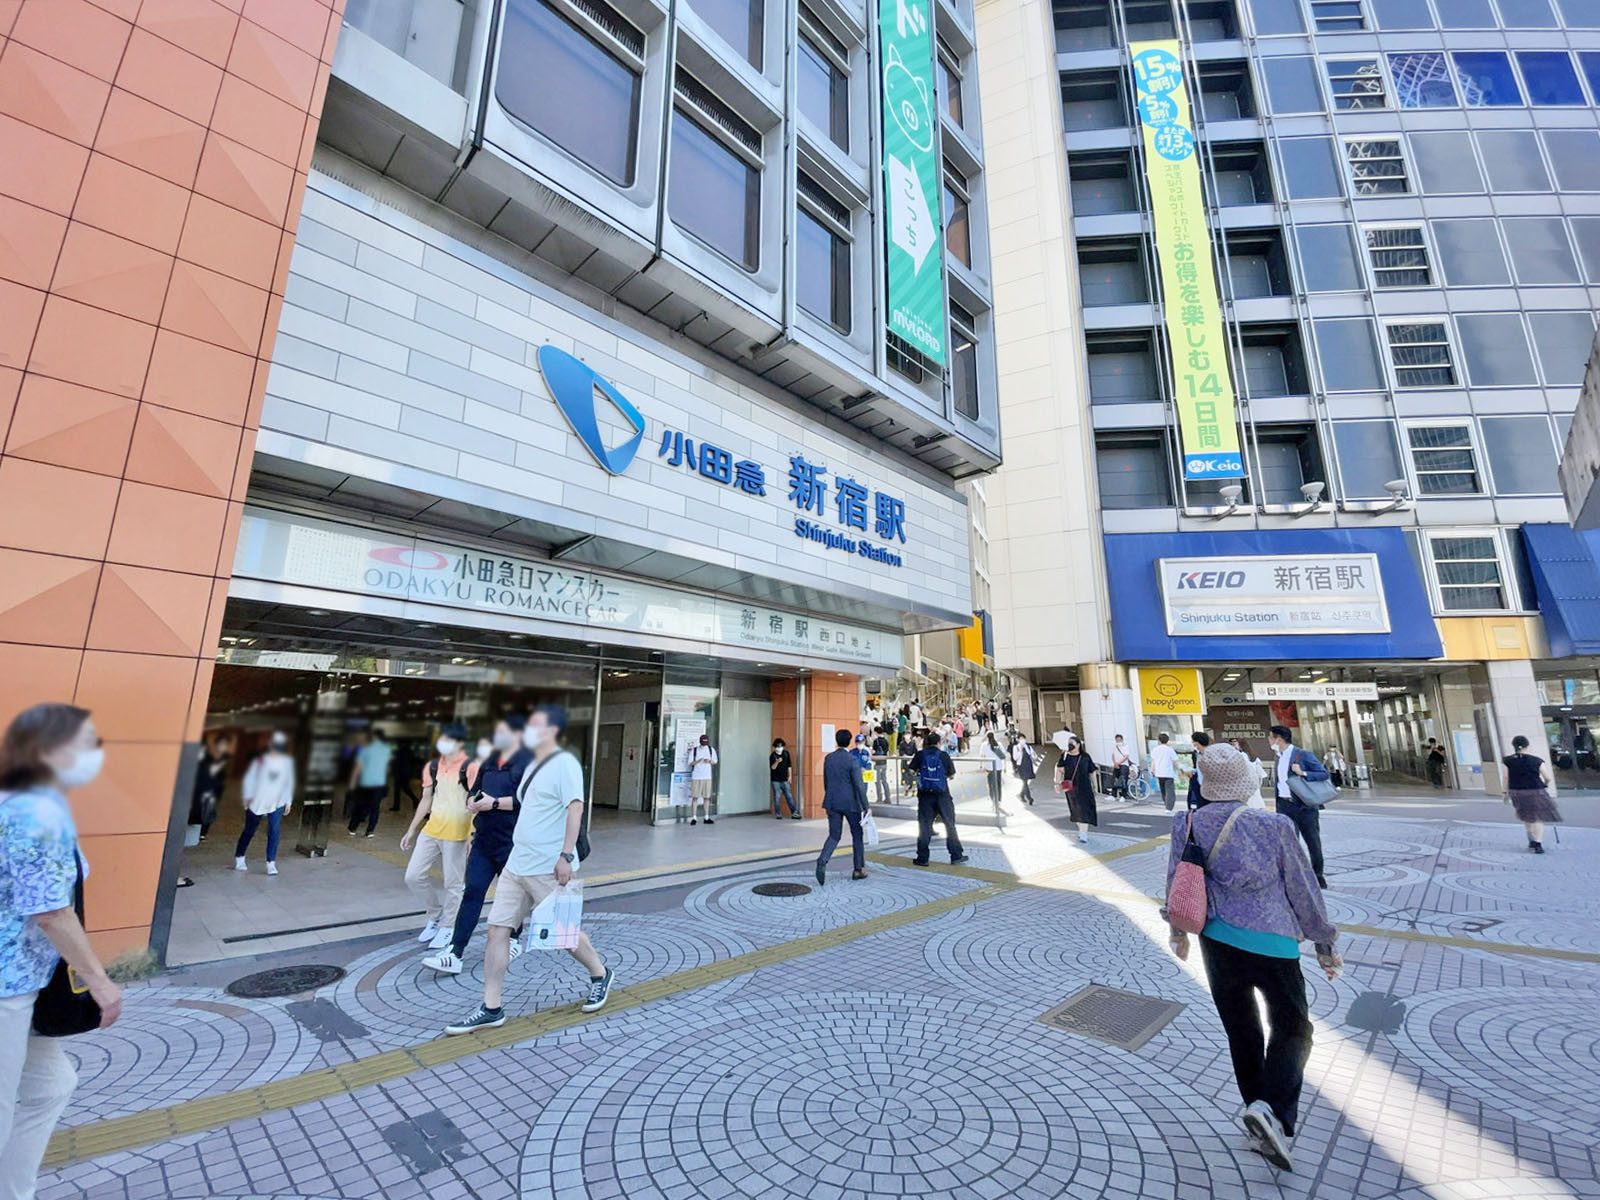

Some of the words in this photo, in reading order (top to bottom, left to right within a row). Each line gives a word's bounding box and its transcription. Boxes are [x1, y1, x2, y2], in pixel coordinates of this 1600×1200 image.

[1133, 55, 1181, 81] 15%
[1146, 75, 1176, 93] 割引
[1145, 95, 1170, 112] 5%
[904, 177, 917, 247] こっち
[1173, 242, 1223, 448] お得を楽しむ14日間
[1205, 458, 1241, 472] Keio
[659, 430, 766, 496] 小田急
[789, 455, 907, 544] 新宿駅
[795, 518, 856, 554] Shinjuku
[858, 539, 902, 567] Station
[363, 567, 472, 600] ODAKYU
[485, 588, 619, 623] ROMANCECAR
[453, 553, 621, 600] 小田急ロマンスカー
[1177, 571, 1246, 590] KEIO
[1273, 565, 1366, 592] 新宿駅
[1180, 612, 1231, 624] Shinjuku
[1234, 612, 1279, 623] Station
